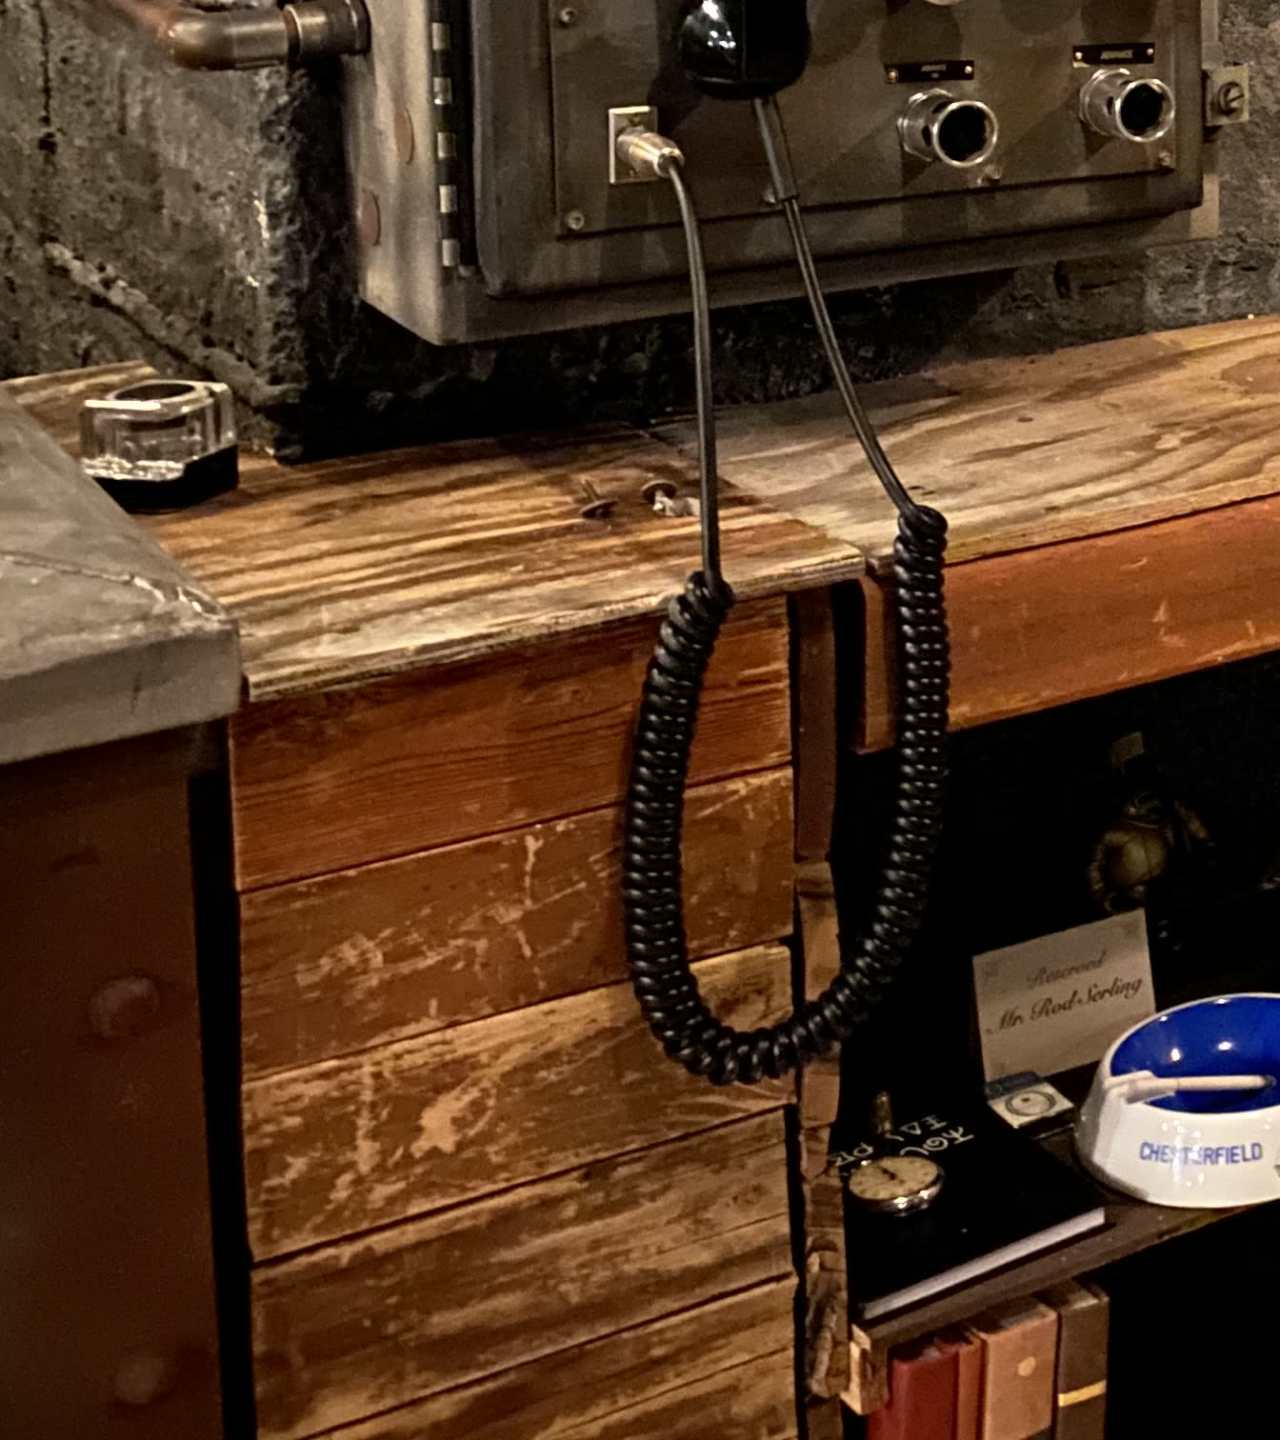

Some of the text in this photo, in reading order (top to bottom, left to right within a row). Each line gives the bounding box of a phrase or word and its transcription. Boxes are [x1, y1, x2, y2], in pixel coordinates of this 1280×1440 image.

[1030, 989, 1078, 1022] Rod
[1077, 976, 1143, 1008] Serling
[1139, 1142, 1264, 1165] CHETRFIELD
